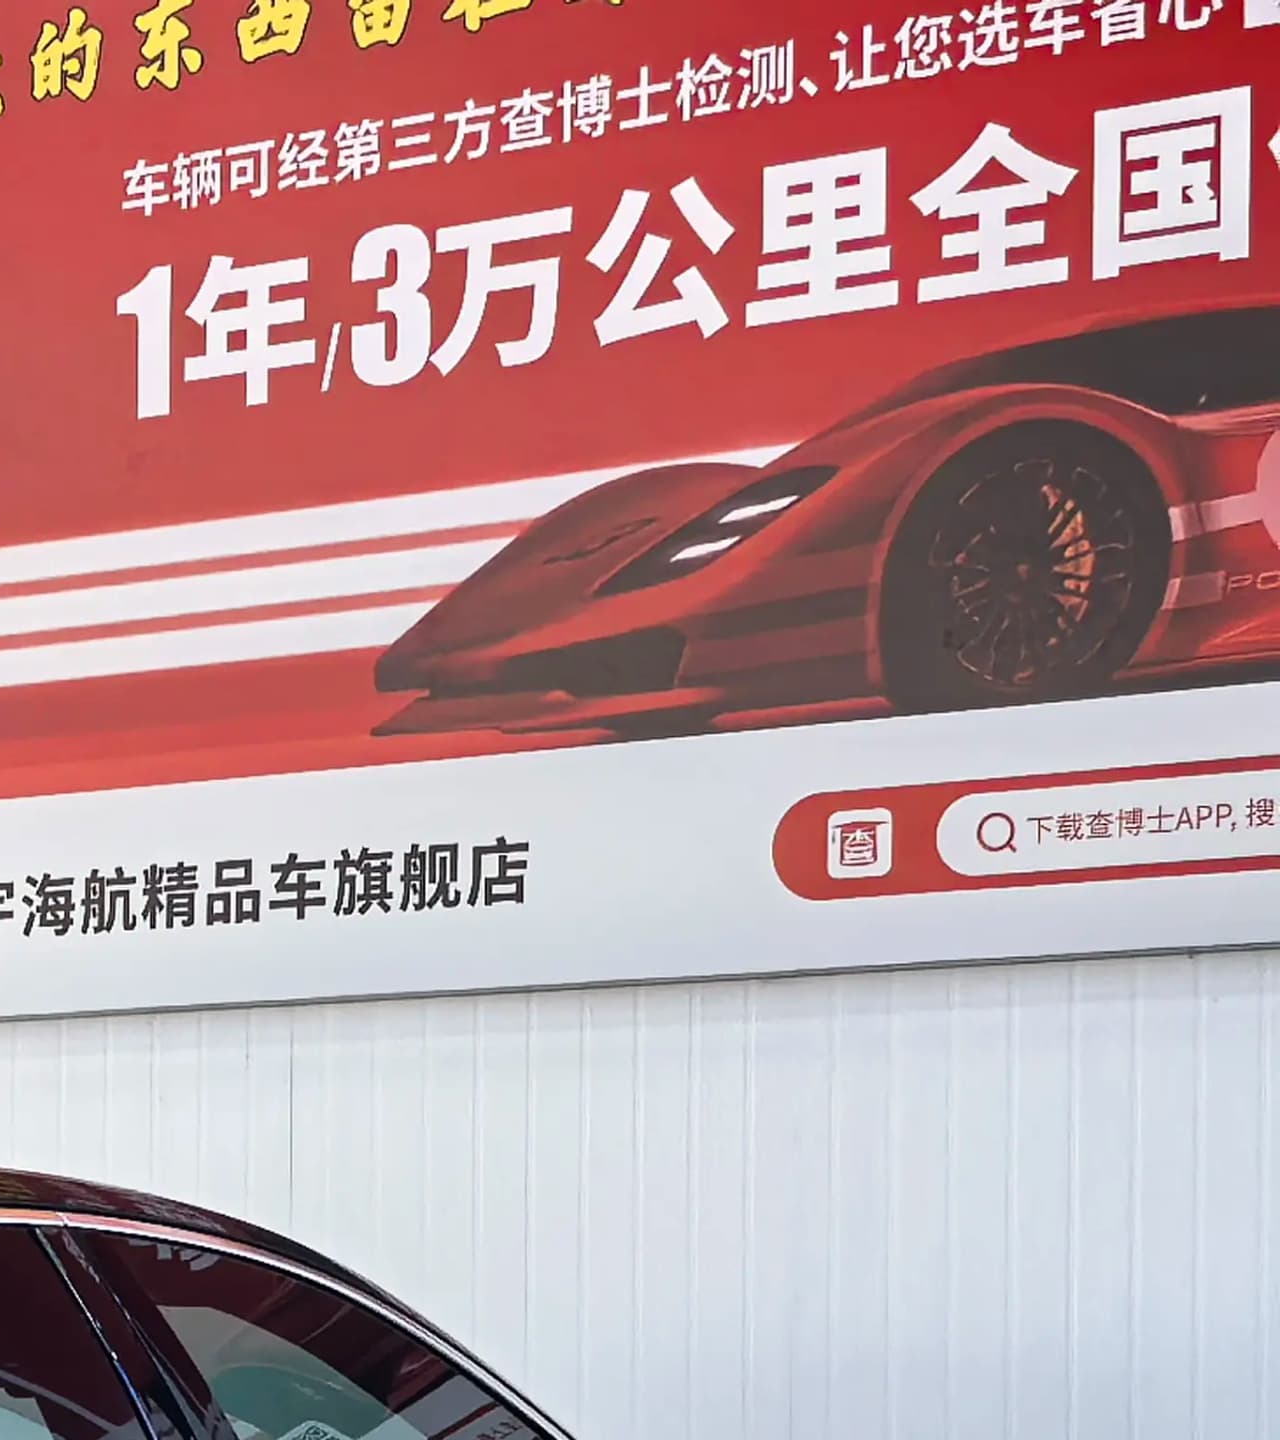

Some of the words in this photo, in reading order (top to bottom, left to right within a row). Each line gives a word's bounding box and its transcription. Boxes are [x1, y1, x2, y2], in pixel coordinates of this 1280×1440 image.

[115, 85, 1280, 421] 1年/3万公里全国
